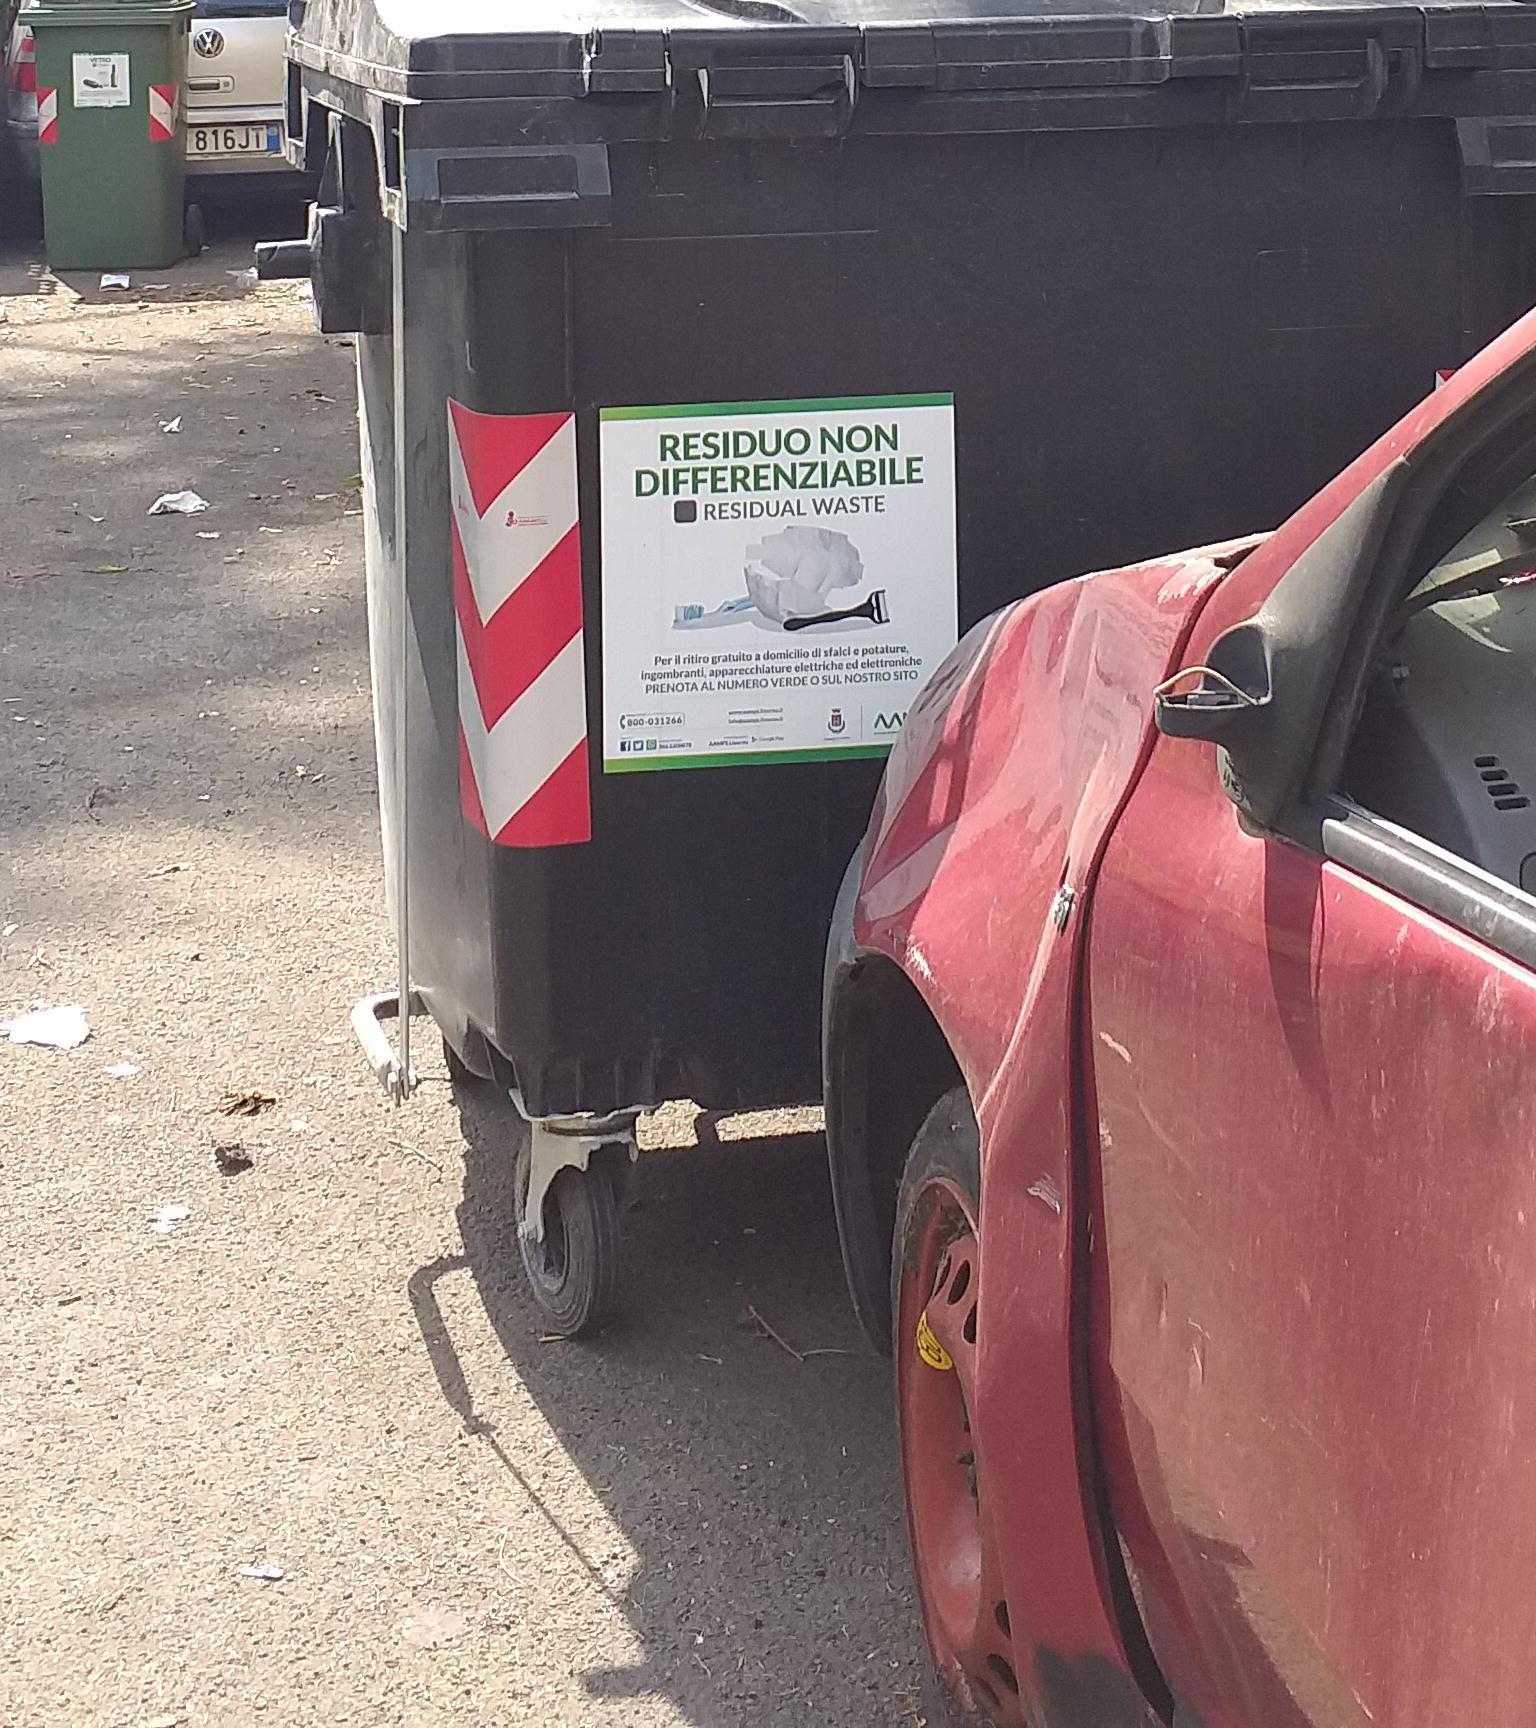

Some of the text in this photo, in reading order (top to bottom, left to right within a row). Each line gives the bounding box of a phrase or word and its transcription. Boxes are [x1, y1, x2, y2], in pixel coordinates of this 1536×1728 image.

[195, 127, 264, 152] 816JT
[659, 423, 899, 462] RESIDUO NON
[635, 456, 924, 498] DIFFERENZIABILE
[704, 494, 886, 521] RESIDUAL WASTE
[654, 656, 673, 666] Per
[674, 654, 681, 665] il
[683, 653, 709, 665] ritiro
[711, 652, 752, 665] gratuito
[754, 652, 761, 661] a
[763, 648, 810, 661] domicilio
[811, 647, 821, 658] di
[824, 646, 851, 657] sfalci
[861, 643, 910, 657] potature,
[641, 656, 923, 682] ingombranti, apparecchiature elettriche ed elettroniche
[645, 669, 919, 694] PRENOTA AL NUMERO VERDE O SUL NOSTRO SITO
[627, 716, 683, 727] 800-031266
